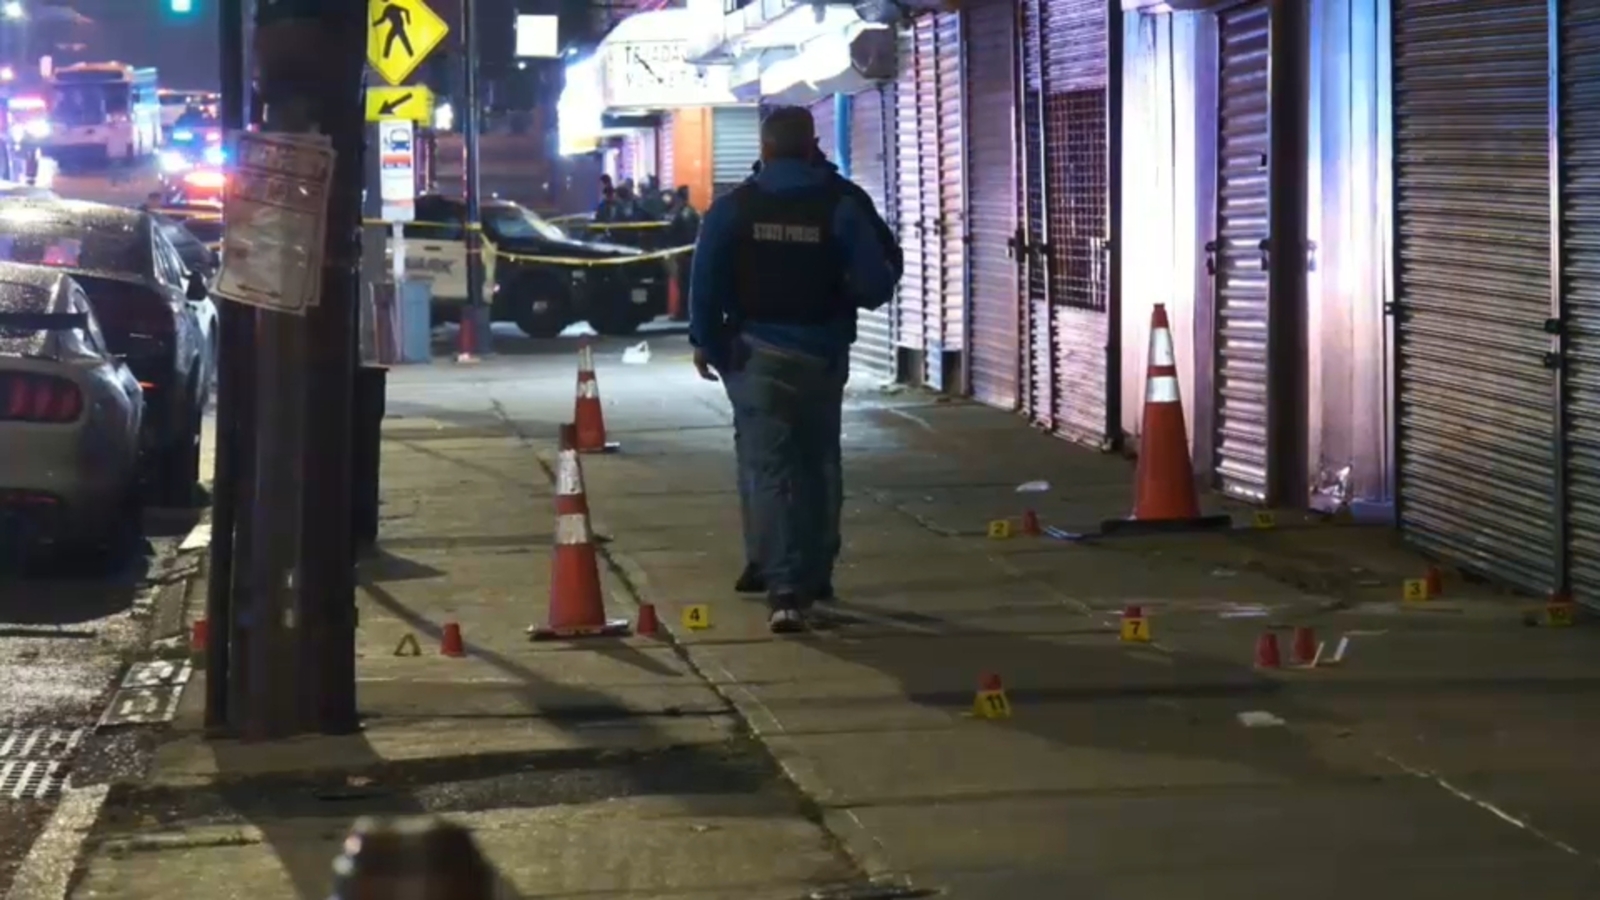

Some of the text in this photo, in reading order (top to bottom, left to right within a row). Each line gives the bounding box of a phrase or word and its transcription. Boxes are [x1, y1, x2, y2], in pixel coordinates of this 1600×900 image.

[993, 522, 1005, 535] 2
[1410, 582, 1421, 596] 3
[689, 607, 701, 622] 4
[1129, 620, 1142, 636] 7
[986, 694, 1004, 711] 11
